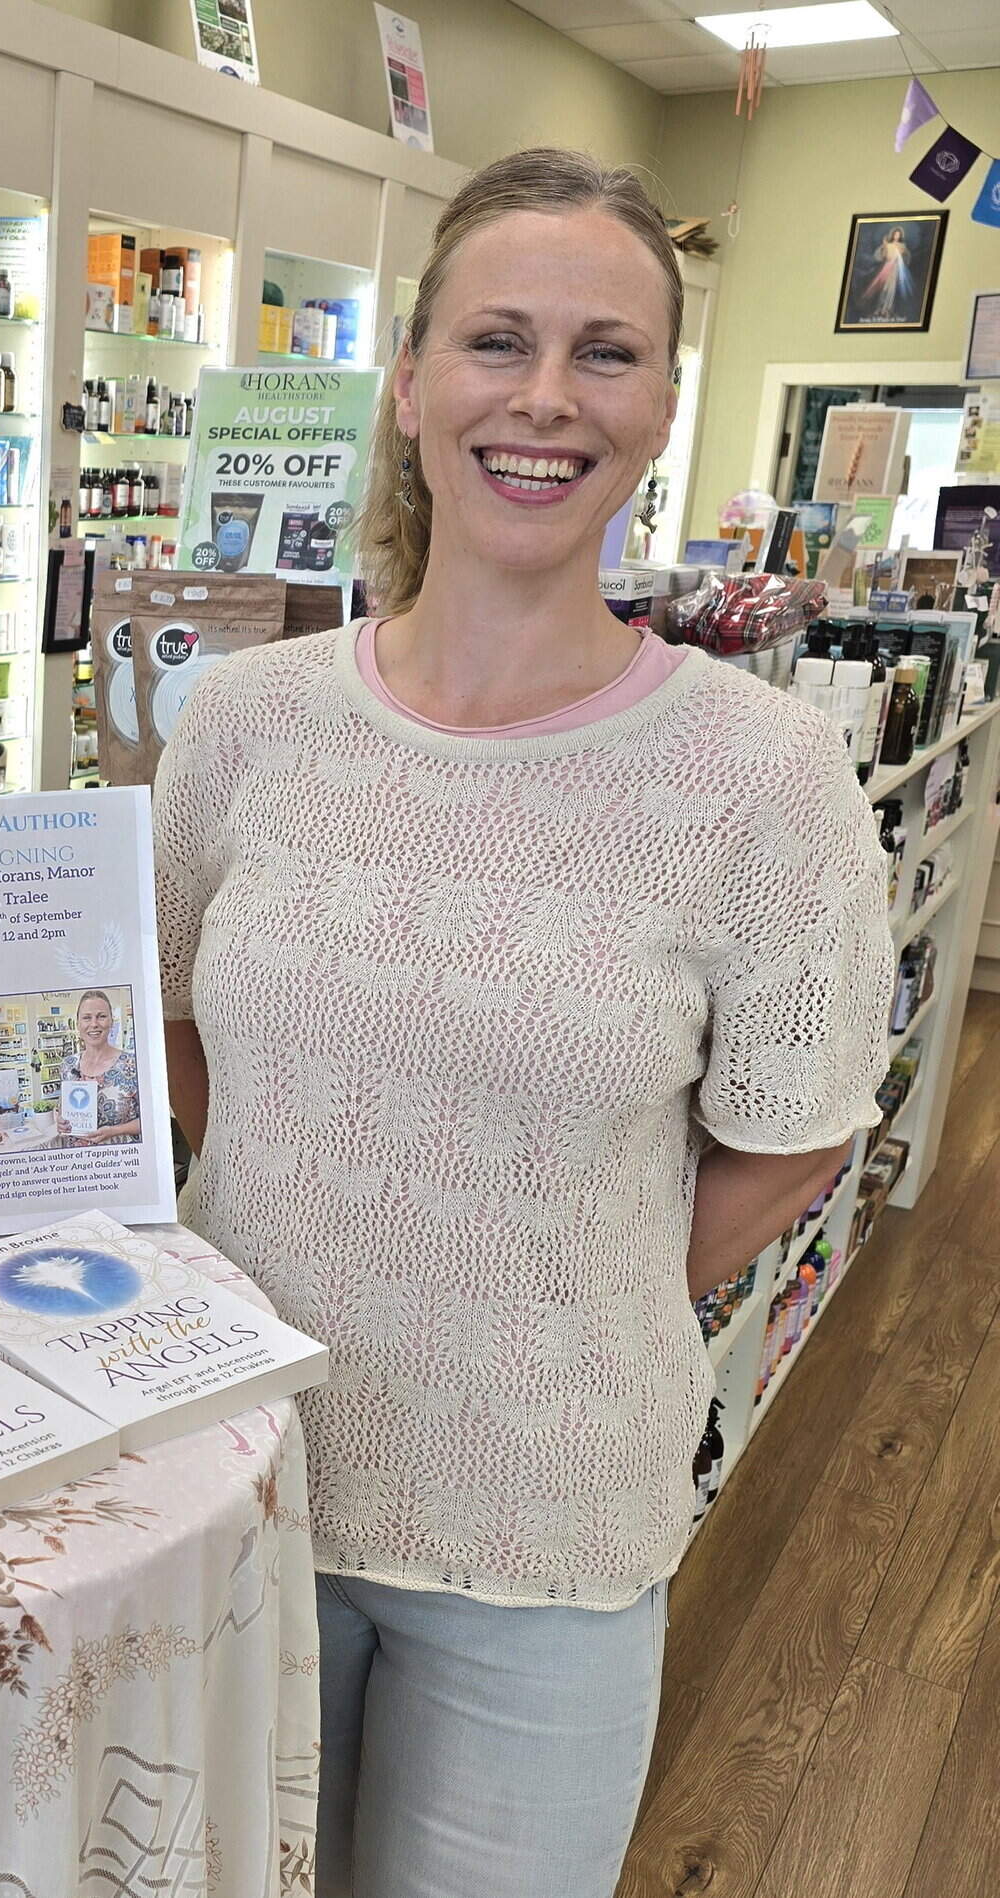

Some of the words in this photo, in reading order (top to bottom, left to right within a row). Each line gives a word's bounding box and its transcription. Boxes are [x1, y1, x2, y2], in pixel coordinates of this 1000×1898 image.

[249, 373, 342, 391] HORANS
[258, 393, 325, 401] HEALTHSTORE
[234, 407, 336, 424] AUGUST
[208, 427, 282, 440] SPECIAL
[288, 428, 358, 441] OFFERS
[216, 453, 274, 476] 20%
[284, 455, 342, 477] OFF
[218, 479, 242, 487] THESE
[243, 480, 287, 488] CUSTOMER
[288, 480, 335, 489] FAVOURITES
[195, 548, 217, 557] 20%
[194, 557, 215, 566] OFF
[117, 630, 132, 647] tru
[160, 637, 188, 655] true
[48, 866, 95, 880] Manor
[4, 891, 49, 905] Tralee
[10, 914, 21, 924] of
[24, 909, 82, 923] September
[2, 932, 16, 942] 12
[17, 930, 38, 940] and
[41, 928, 66, 939] 2pm
[48, 1153, 74, 1161] author
[75, 1151, 83, 1159] of
[50, 1164, 68, 1172] Your
[71, 1162, 93, 1172] Angel
[22, 1178, 50, 1186] answer
[51, 1175, 88, 1186] questions
[89, 1172, 111, 1180] about
[113, 1170, 137, 1180] angels
[11, 1190, 27, 1200] sign
[29, 1188, 51, 1198] copies
[63, 1185, 75, 1193] her
[78, 1184, 98, 1193] latest
[100, 1183, 119, 1191] book
[9, 1229, 60, 1252] Browne
[45, 1296, 210, 1353] TAPPING
[97, 1331, 164, 1369] with
[165, 1316, 211, 1340] the
[96, 1323, 260, 1388] ANGELS
[141, 1381, 172, 1398] Angel
[172, 1374, 193, 1389] EFT
[196, 1366, 215, 1379] and
[216, 1348, 269, 1371] Ascension
[157, 1384, 201, 1402] through
[202, 1376, 221, 1388] the
[222, 1371, 233, 1380] 12
[234, 1356, 276, 1374] Chakras
[0, 1431, 57, 1456] Ascension
[2, 1459, 15, 1469] 12
[16, 1442, 63, 1463] Chakras
